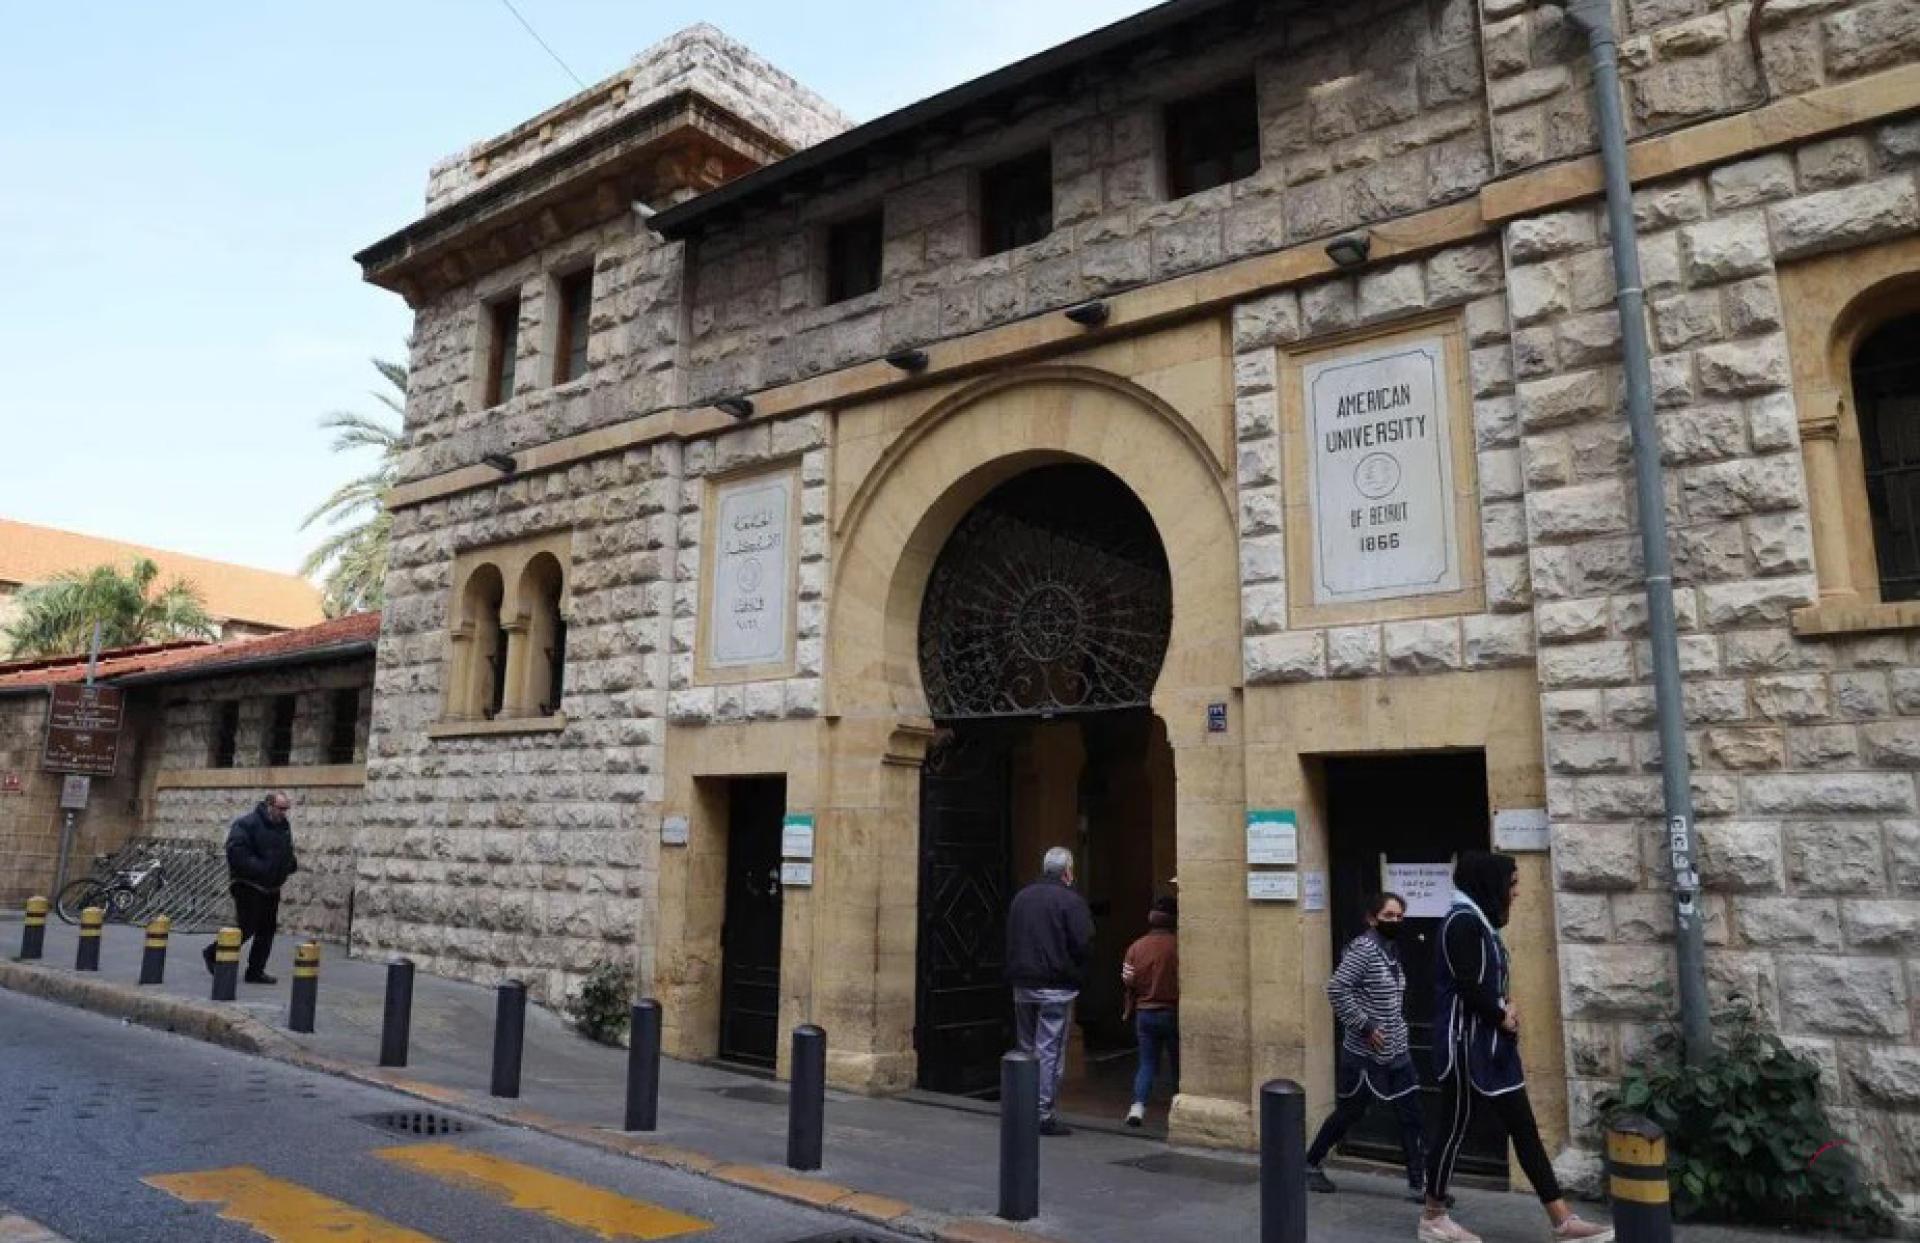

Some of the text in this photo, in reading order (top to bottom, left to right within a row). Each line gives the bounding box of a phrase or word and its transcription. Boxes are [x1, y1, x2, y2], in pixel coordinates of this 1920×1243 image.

[1337, 384, 1411, 418] AMERICAN
[1325, 415, 1426, 453] UNIVERSITY
[1350, 502, 1408, 529] OF BEIRUT
[1360, 533, 1400, 553] 1866
